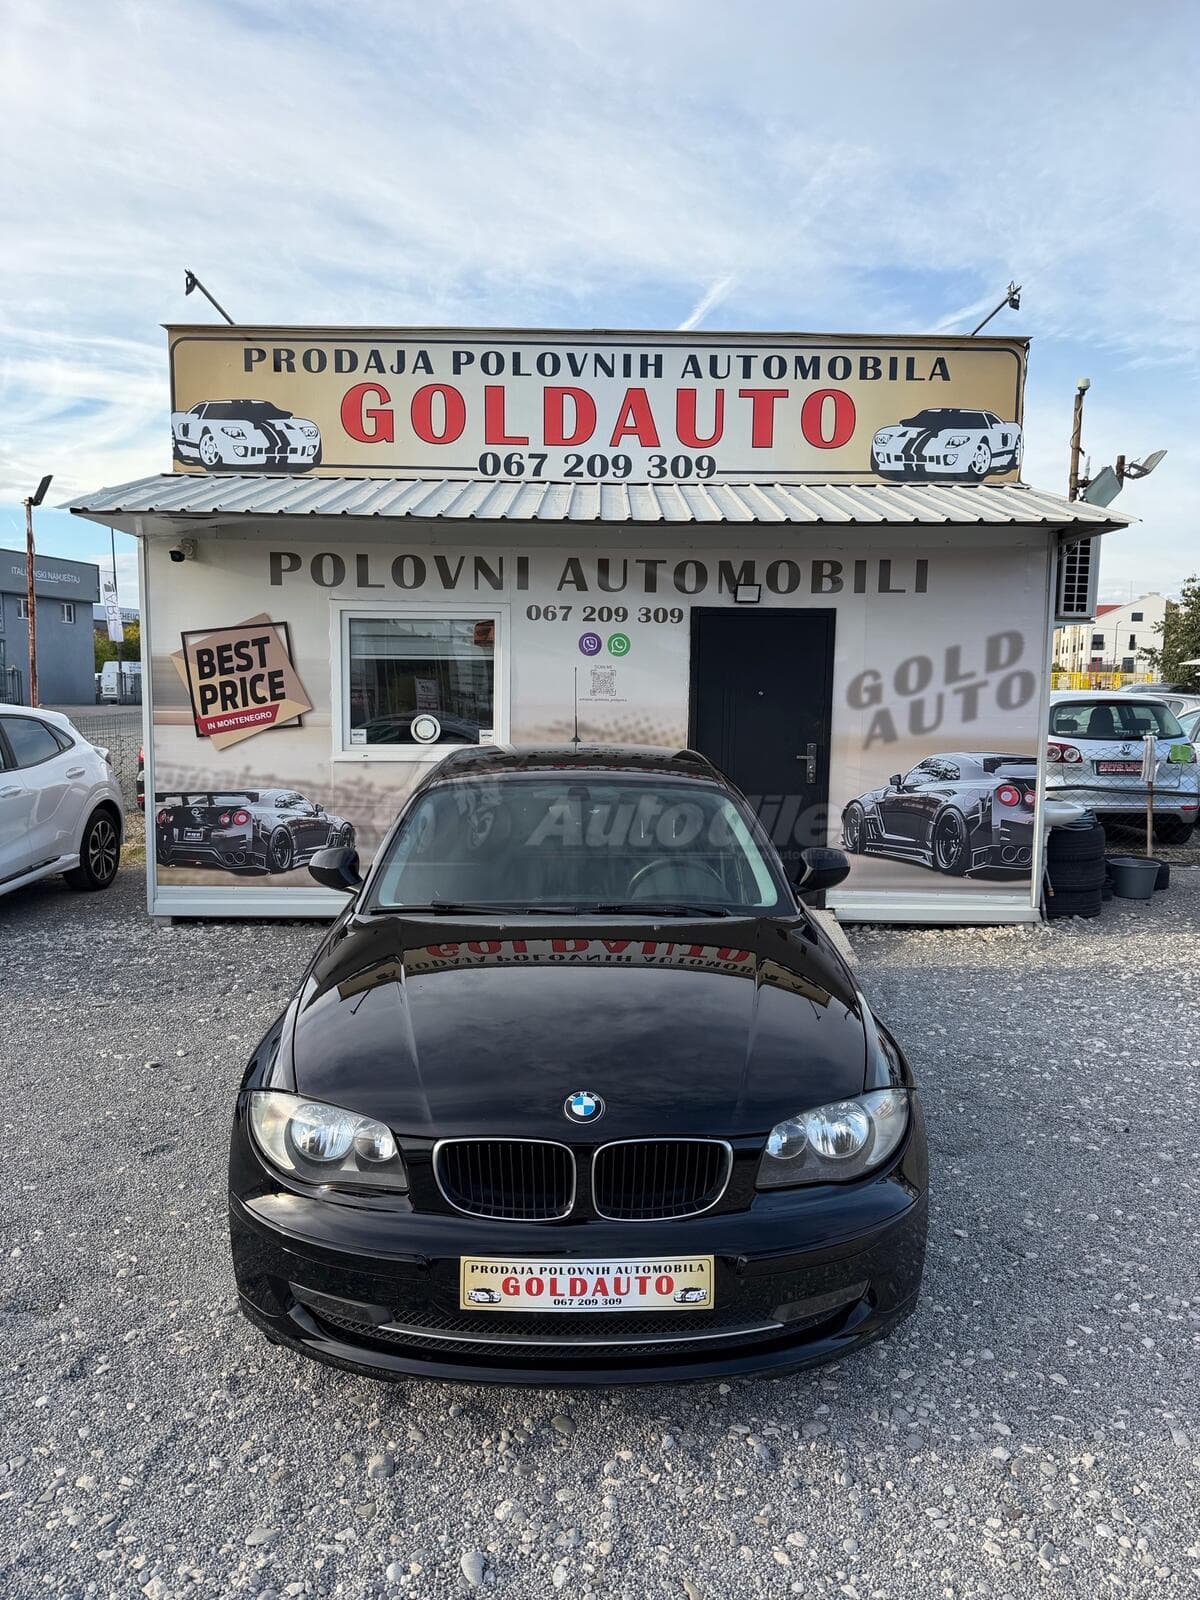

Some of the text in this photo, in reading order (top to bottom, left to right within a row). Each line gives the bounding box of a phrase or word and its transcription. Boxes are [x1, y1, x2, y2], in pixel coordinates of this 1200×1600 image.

[243, 347, 952, 382] PRODAJA POLOVNIH AUTOMOBILA
[340, 381, 857, 449] GOLDAUTO
[478, 451, 717, 480] 067 209 309
[269, 551, 929, 594] POLOVNI AUTOMOBILI
[525, 604, 684, 624] 067 209 309
[196, 636, 271, 681] BEST
[846, 629, 1025, 711] GOLD
[199, 669, 286, 716] PRICE
[864, 669, 1036, 750] AUTO
[207, 711, 273, 730] IN MONTENEGRO
[471, 1263, 705, 1276] PRODAJA POLOVNIH AUTOMOBILA
[502, 1275, 675, 1297] GOLDAUTO
[601, 1298, 622, 1306] 309
